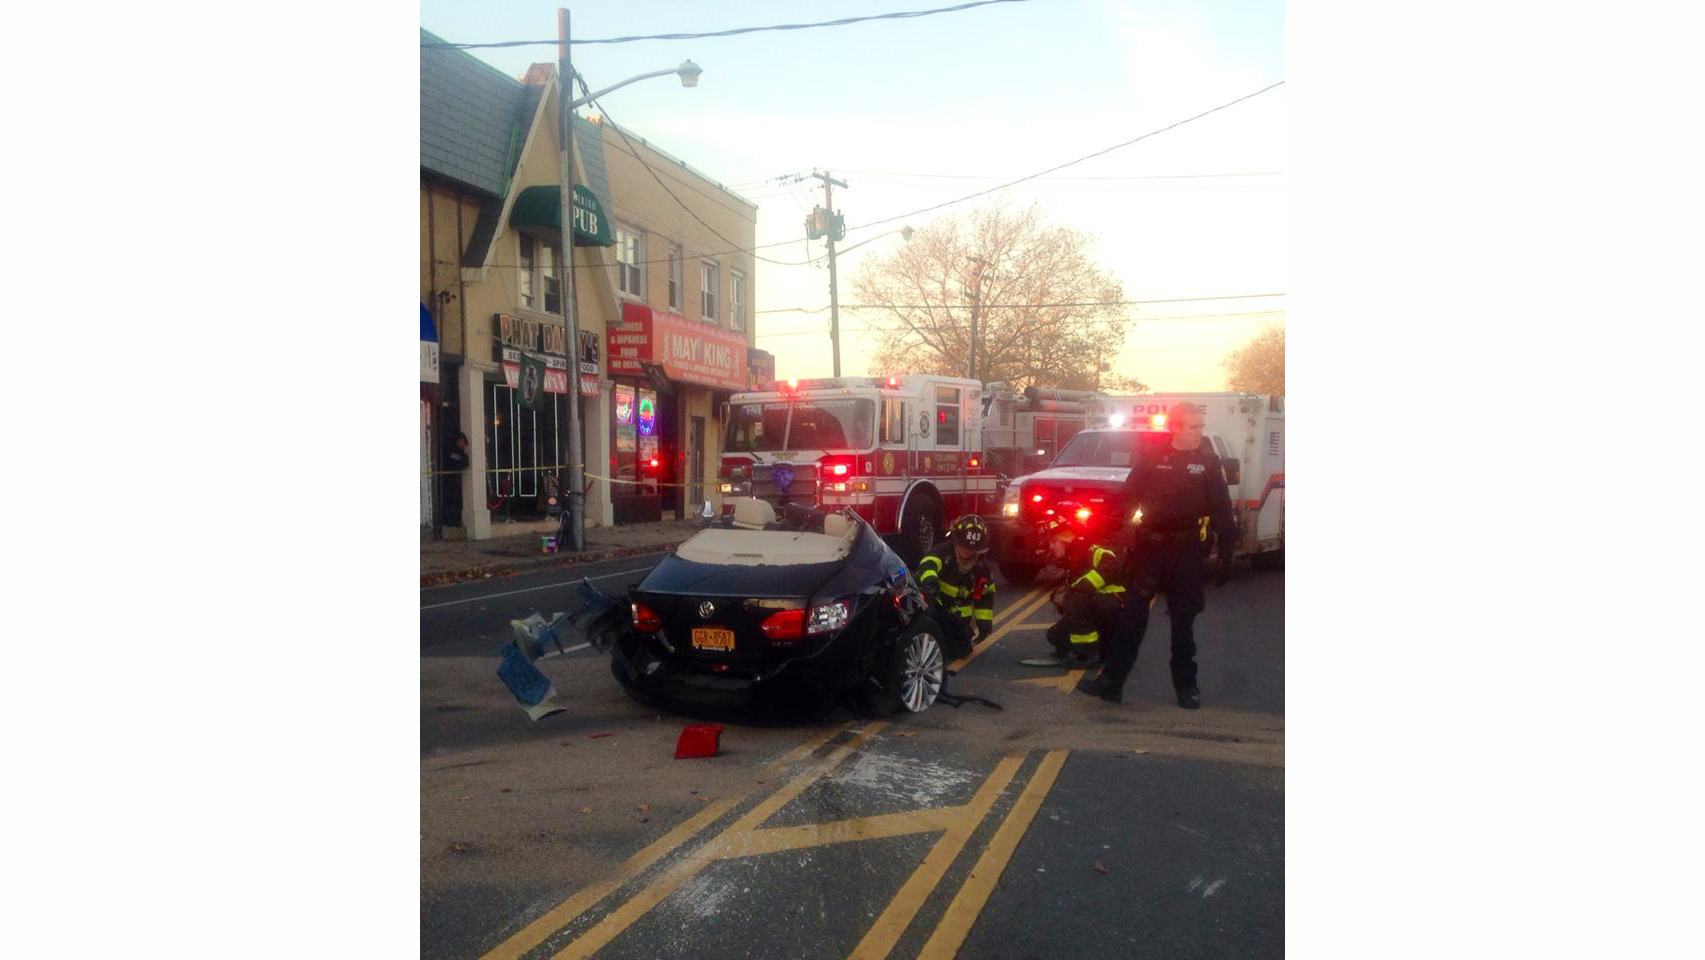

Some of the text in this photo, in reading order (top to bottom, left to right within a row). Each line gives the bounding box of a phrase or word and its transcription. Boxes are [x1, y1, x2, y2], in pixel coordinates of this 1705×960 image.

[573, 205, 598, 235] PUB
[500, 314, 600, 363] PHAT DAY'S
[620, 347, 638, 358] FOOD
[672, 334, 731, 369] MAY KING
[552, 359, 566, 369] SPIR
[582, 363, 595, 373] OOD
[1132, 404, 1208, 416] POLE
